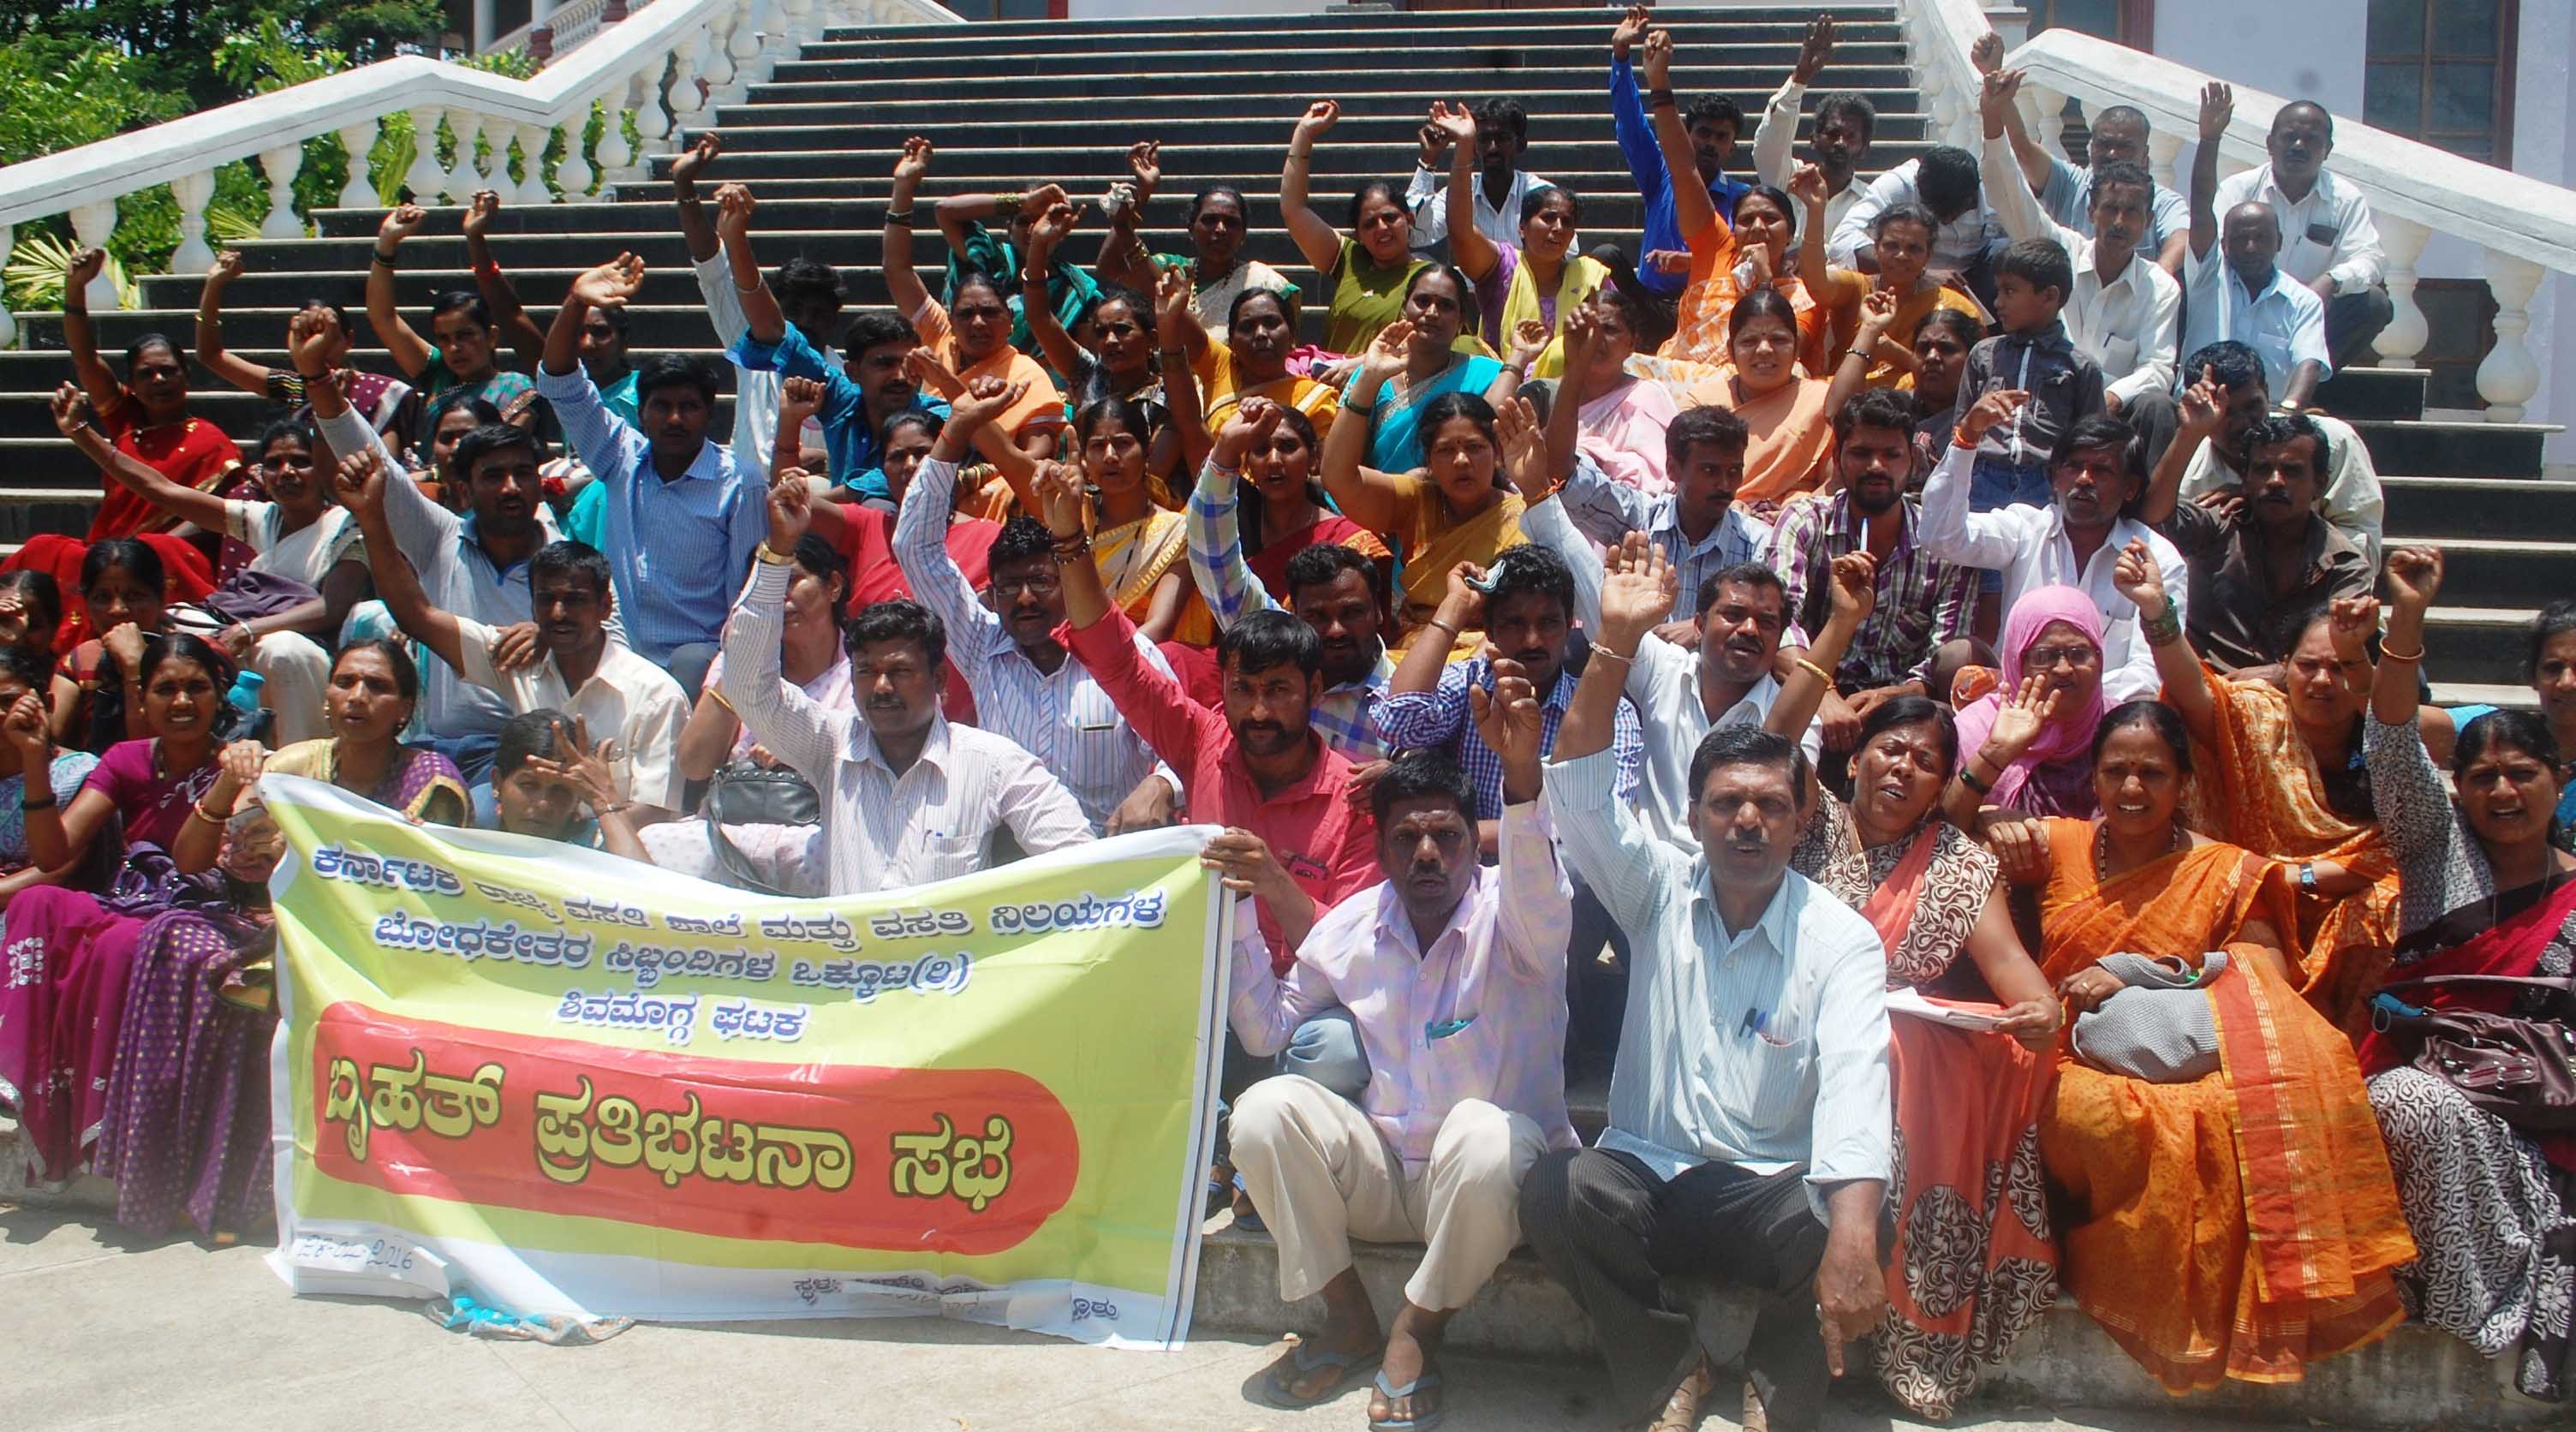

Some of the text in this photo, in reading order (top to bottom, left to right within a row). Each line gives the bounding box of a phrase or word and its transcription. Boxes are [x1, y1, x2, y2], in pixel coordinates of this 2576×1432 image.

[313, 844, 463, 894] ಕರ್ನಾಟಕ
[564, 898, 653, 929] ವಸತಿ
[665, 913, 747, 937] ಶಾಲೆ
[760, 910, 857, 949] ಮತ್ತು
[872, 908, 972, 936] ವಸತಿ
[991, 889, 1166, 933] ನಿಲಯಗಳ
[374, 912, 592, 967] ಬೋಧಕೇತರ
[606, 943, 776, 985] ಸಿಬ್ಬಂದಿಗಳ
[558, 993, 807, 1042] ಶಿವಮೊಗ್ಗ ಘಟಕ
[325, 1047, 1014, 1213] ಬೃಹತ್ ಪ್ರತಿಭಟನಾ ಸಭೆ
